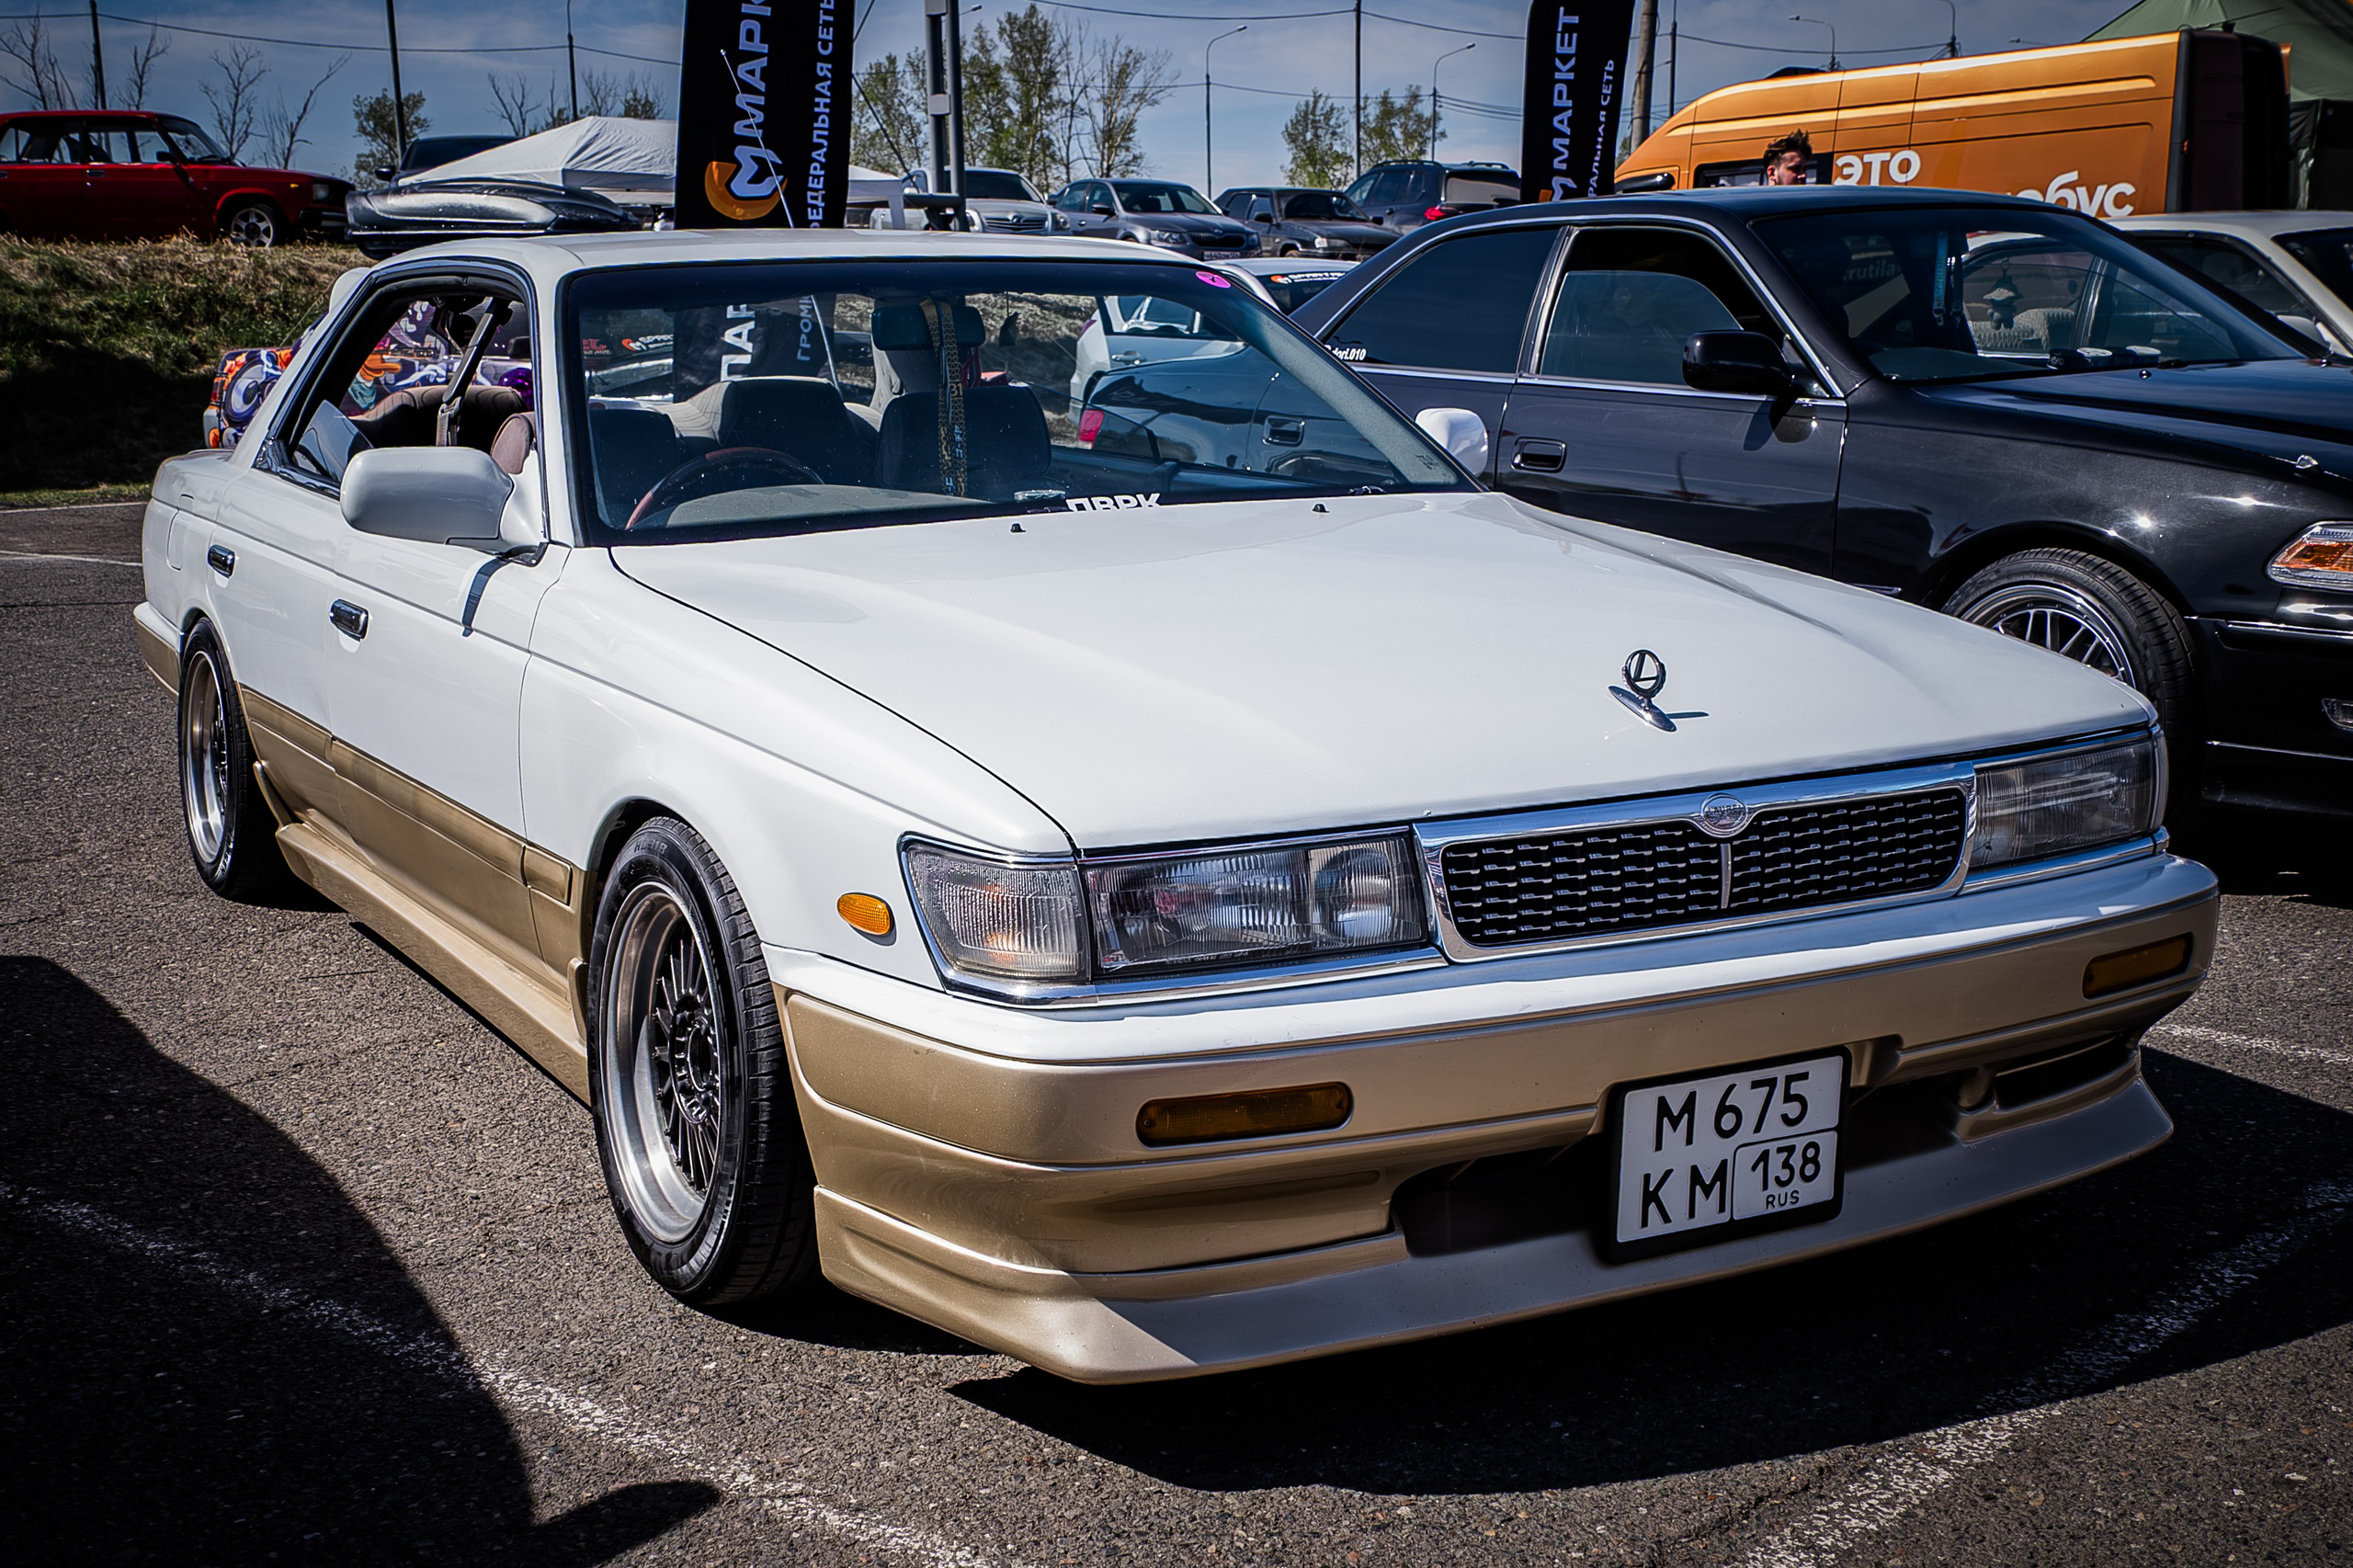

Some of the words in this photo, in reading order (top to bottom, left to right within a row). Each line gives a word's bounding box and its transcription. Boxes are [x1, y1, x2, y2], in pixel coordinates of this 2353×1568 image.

[1552, 6, 1579, 170] МАРКЕТ
[1600, 59, 1615, 106] СЕТЬ
[2006, 170, 2136, 218] бус
[1654, 1090, 1697, 1153] М
[1713, 1071, 1810, 1140] 675
[1750, 1141, 1821, 1192] 138
[1766, 1189, 1801, 1210] RUS
